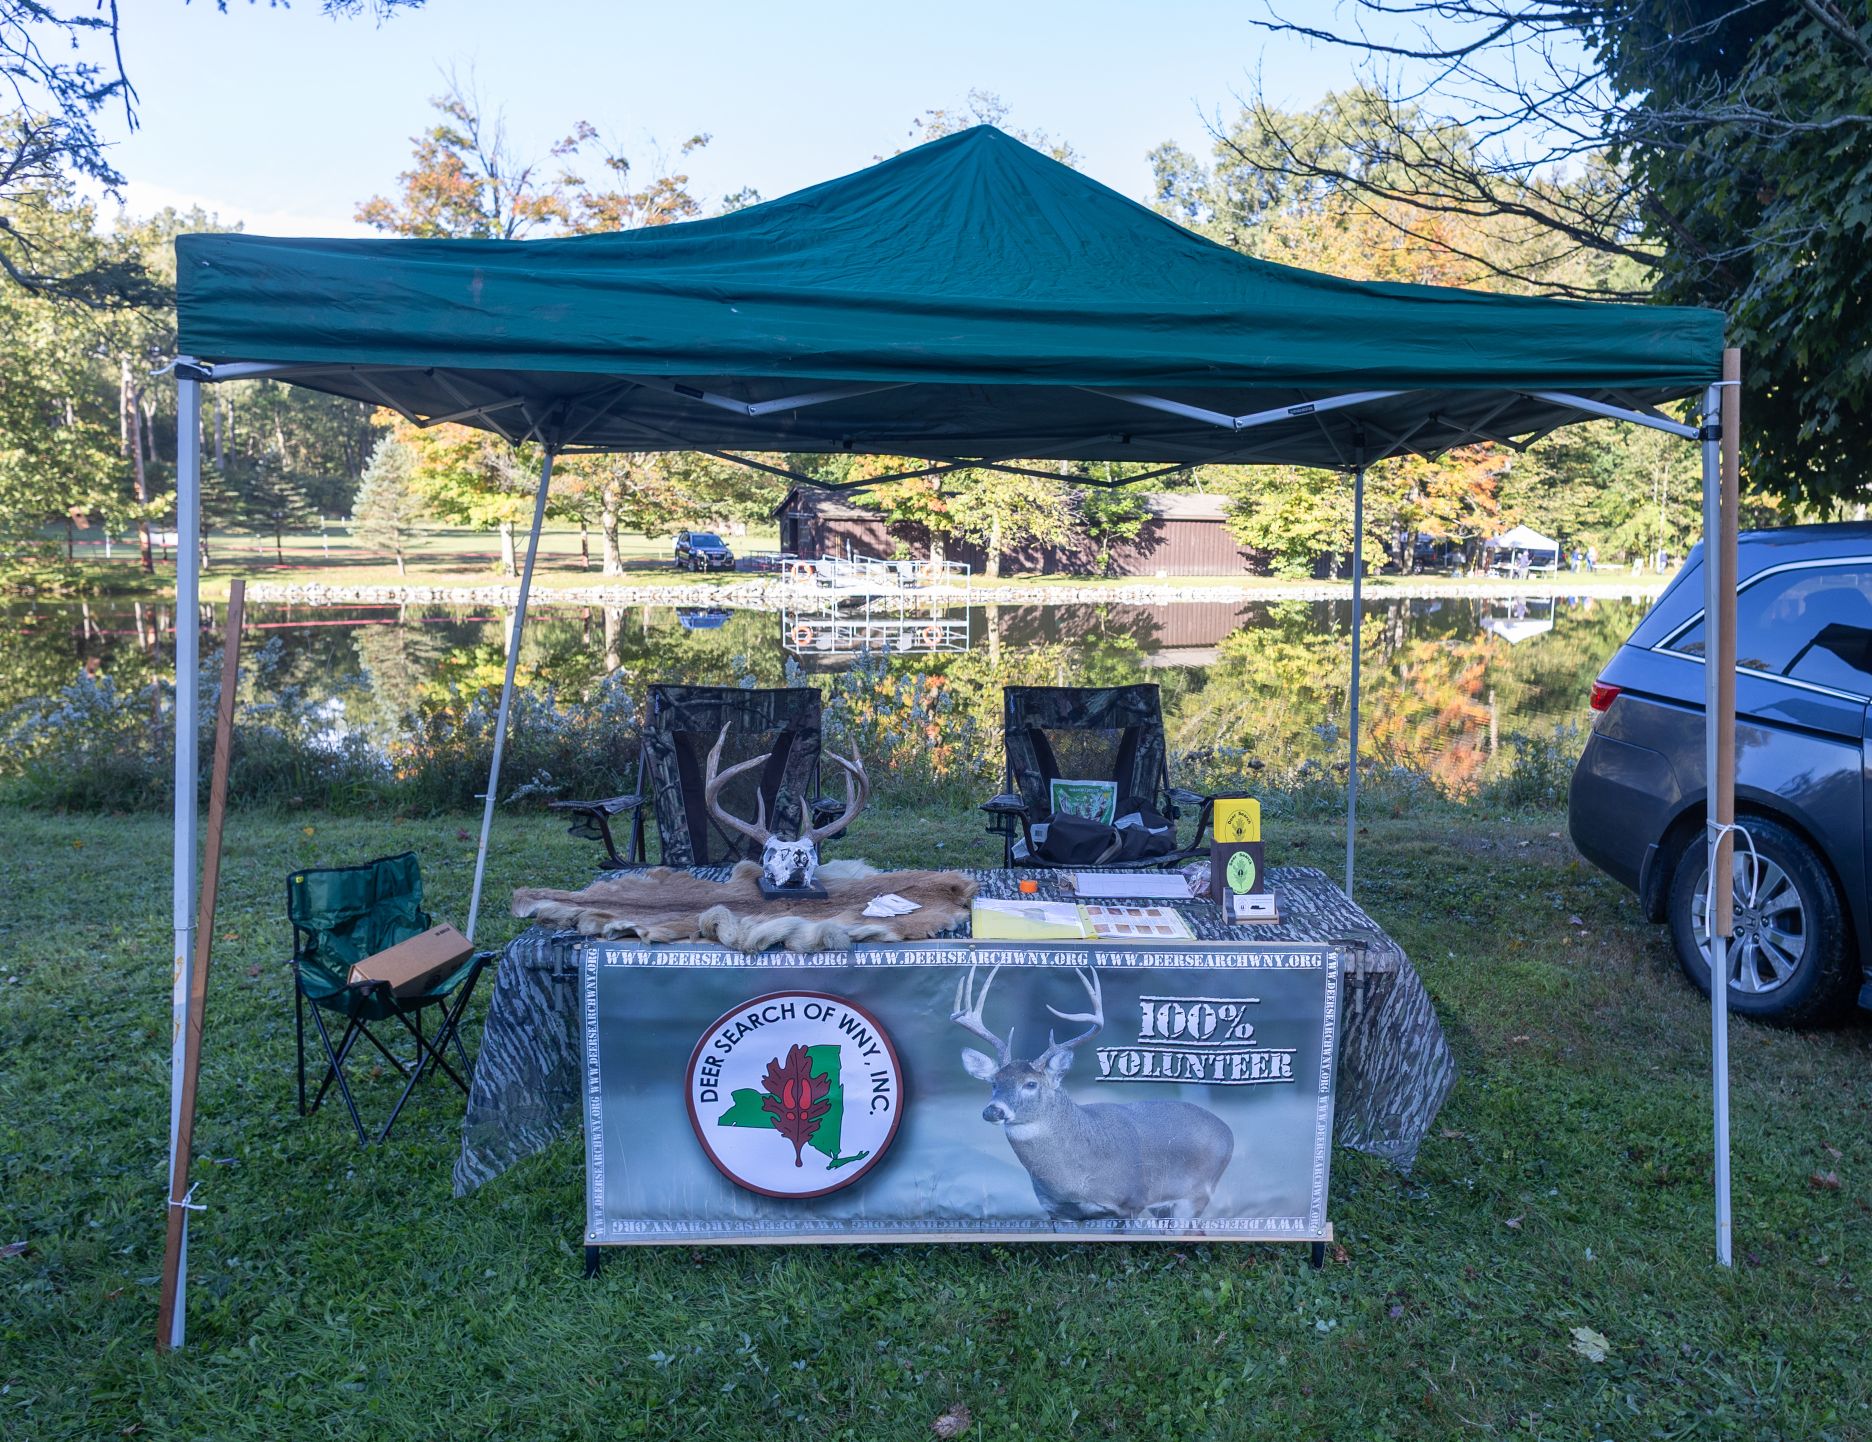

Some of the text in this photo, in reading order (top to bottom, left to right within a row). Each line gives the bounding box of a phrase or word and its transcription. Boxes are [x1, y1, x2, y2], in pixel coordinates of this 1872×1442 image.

[606, 950, 1322, 967] WWW.DEERSEARCHWNY.ORG WWW.DEERSEARCHWNY.ORG WWW.DEERSEARCHWNY.ORG
[586, 947, 600, 1094] WWW.DEERSEARCHWNY.ORG
[1138, 1001, 1254, 1040] 100%
[1320, 951, 1338, 1093] WWW.DEERSEARCHWNY.ORG
[700, 1002, 891, 1116] DEER SEARCH OF WNY, INC.
[1096, 1050, 1294, 1080] VOLUNTEER
